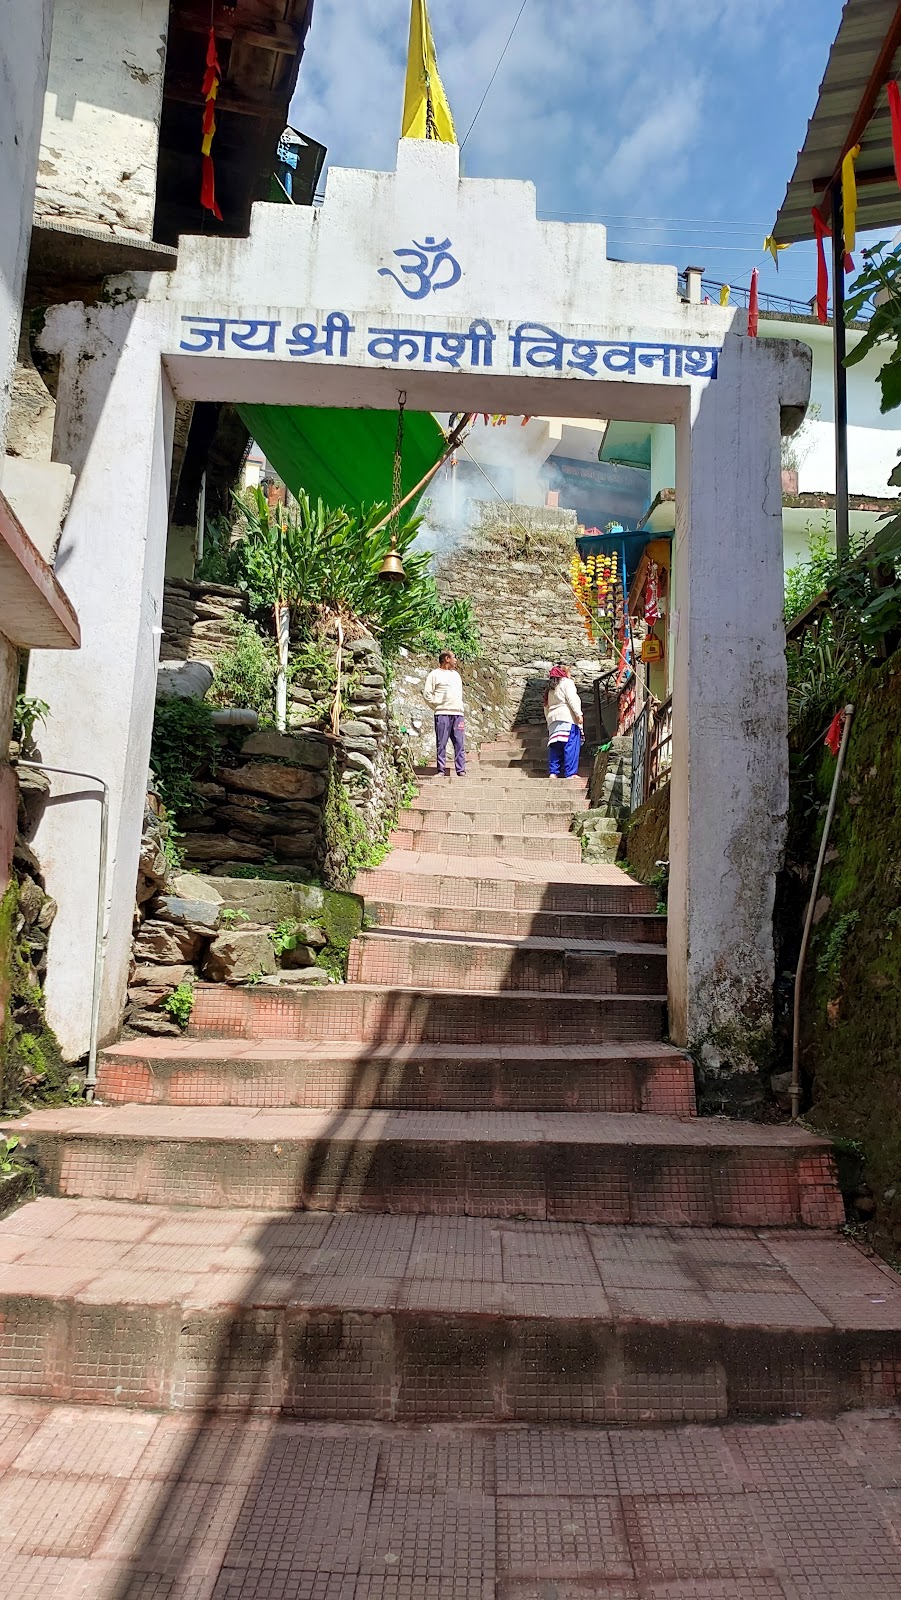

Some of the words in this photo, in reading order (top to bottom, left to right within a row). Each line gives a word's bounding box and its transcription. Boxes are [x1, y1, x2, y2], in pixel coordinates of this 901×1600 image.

[179, 315, 281, 352] जय
[285, 311, 355, 357] श्री
[367, 319, 496, 367] काशी
[508, 321, 723, 380] विश्वनाथ
